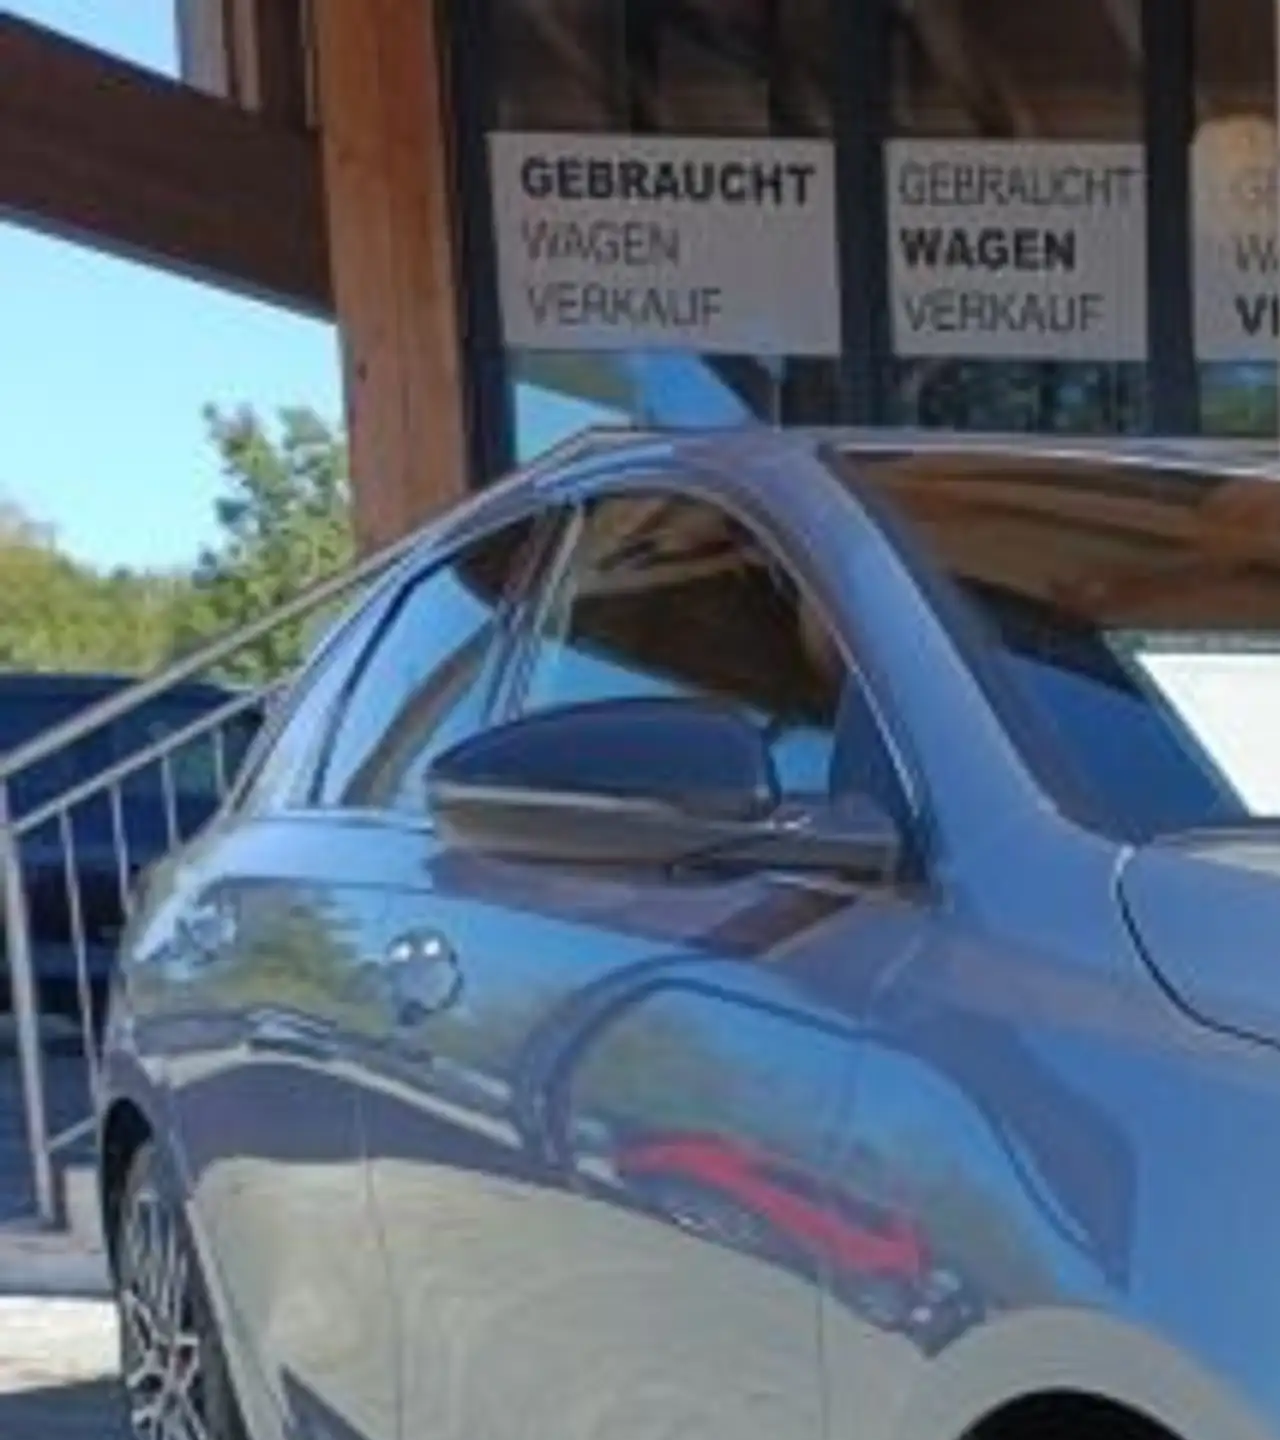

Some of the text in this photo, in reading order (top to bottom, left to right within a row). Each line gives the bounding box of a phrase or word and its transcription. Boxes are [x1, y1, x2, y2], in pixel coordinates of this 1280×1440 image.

[520, 155, 817, 207] GEBRAUCHT
[898, 160, 1143, 208] GEBRAUCHT
[520, 216, 681, 268] WAGEN
[900, 225, 1077, 272] WAGEN
[525, 281, 724, 329] VERKAUF
[904, 288, 1106, 334] VERKAUF
